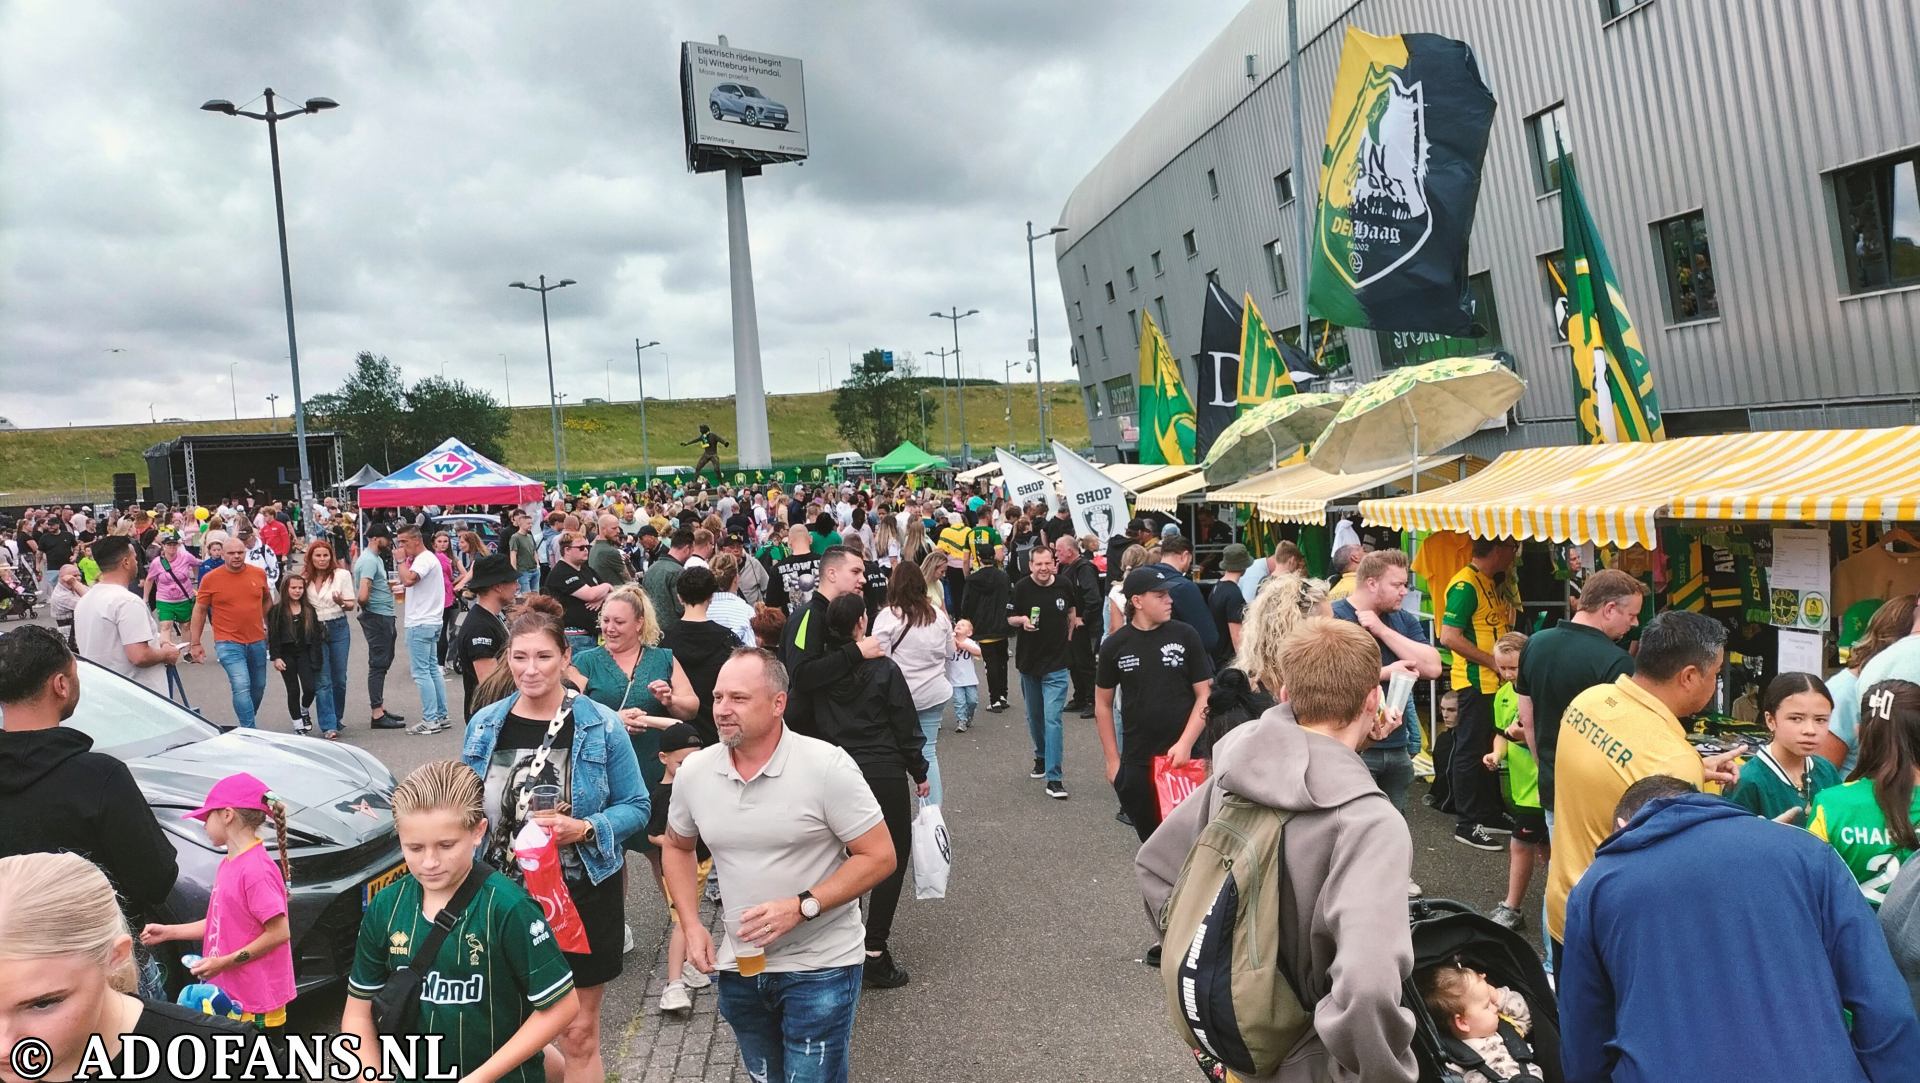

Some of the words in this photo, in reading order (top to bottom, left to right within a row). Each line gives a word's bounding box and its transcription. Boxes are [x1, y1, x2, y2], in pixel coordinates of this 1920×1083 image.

[697, 46, 735, 60] Elektrisch
[736, 52, 758, 64] rijden
[758, 56, 782, 68] begint
[698, 56, 708, 67] bij
[709, 58, 748, 73] Wittebrug
[748, 65, 782, 79] Hyundai.
[1017, 480, 1045, 496] SHOP
[1076, 487, 1112, 505] SHOP
[778, 560, 813, 574] BLOW
[1749, 566, 1761, 600] DEN
[1186, 922, 1208, 970] PUMA
[1183, 976, 1201, 1022] PUMA
